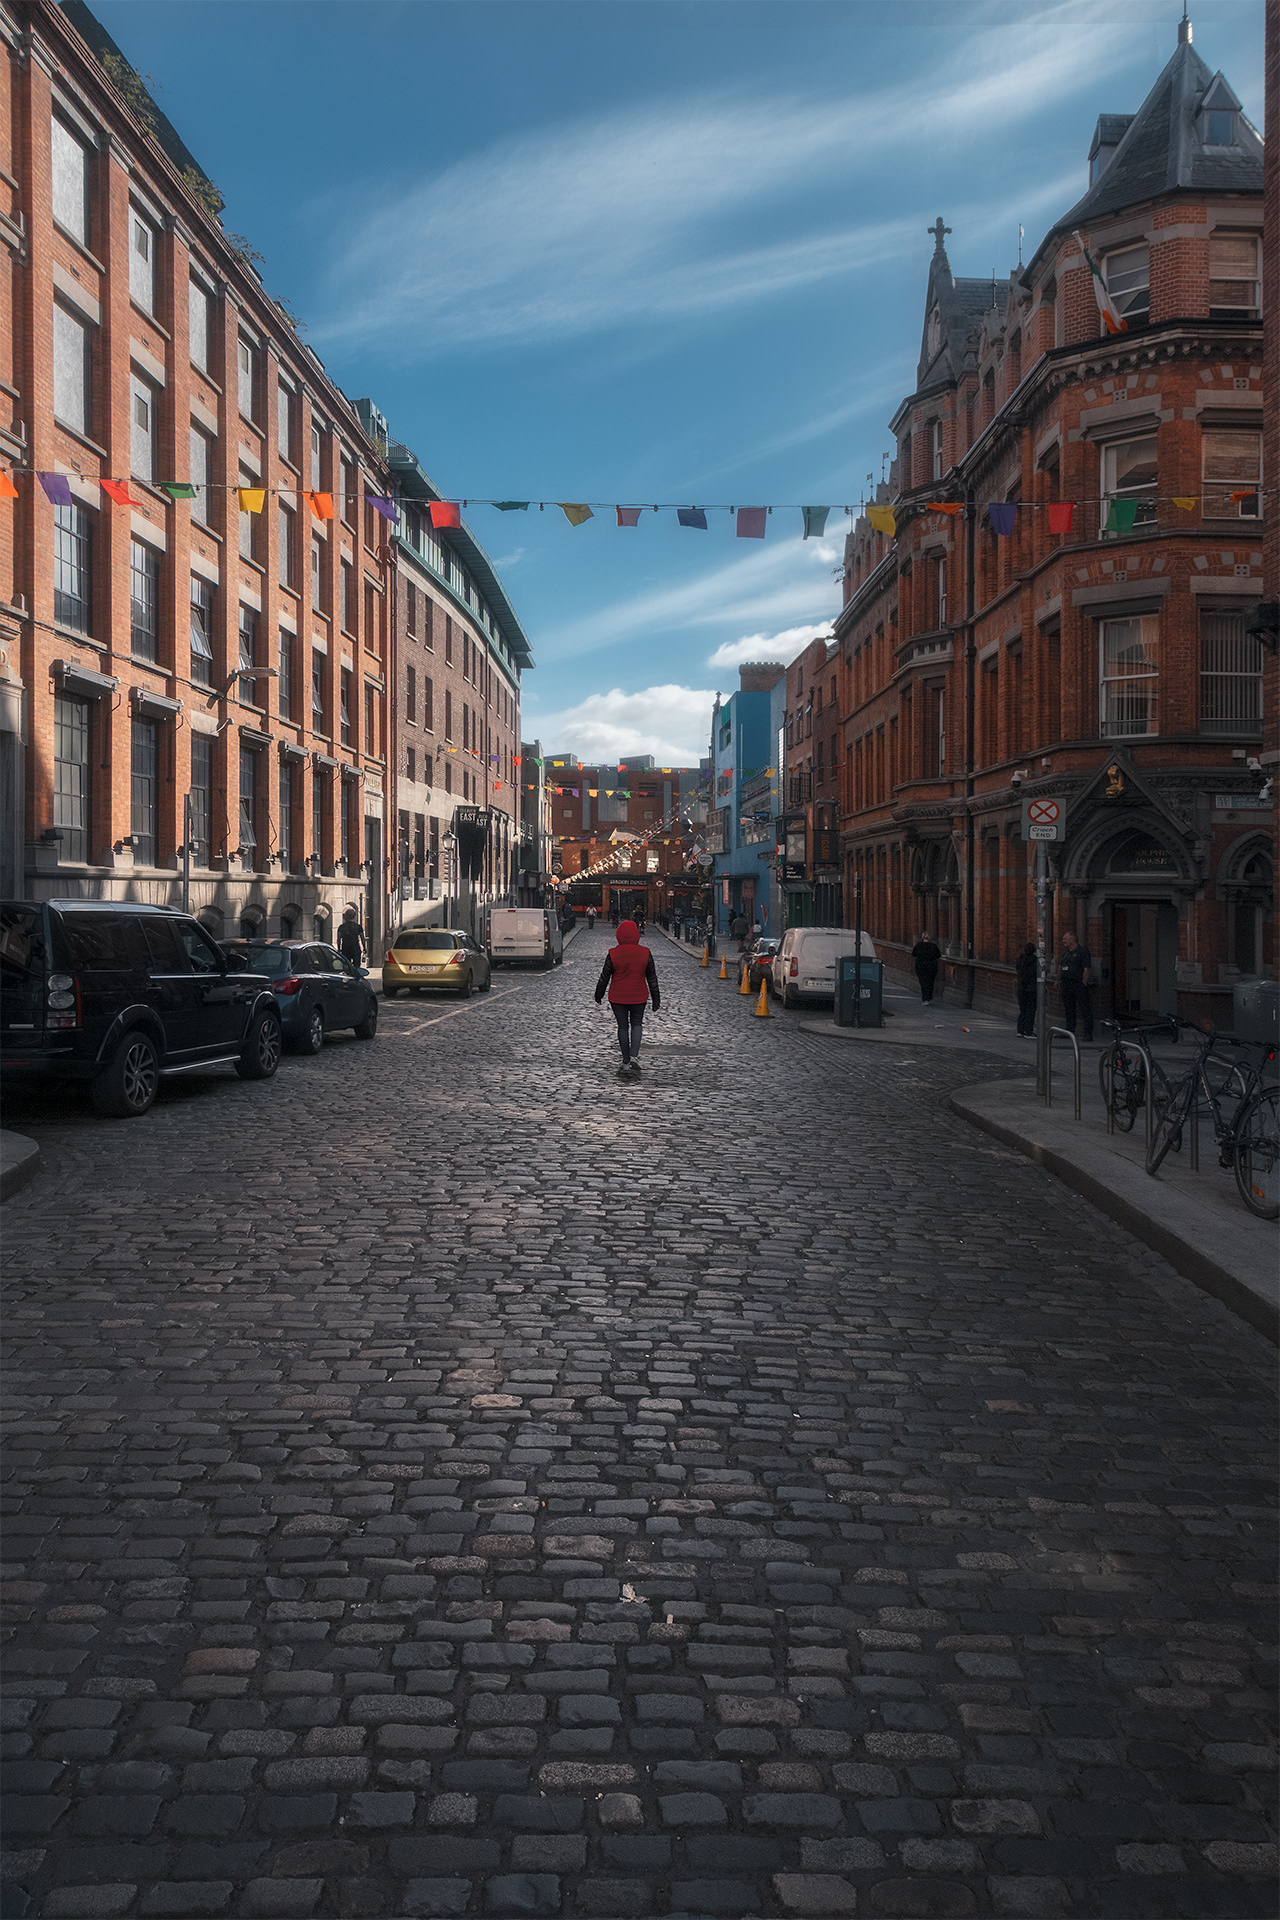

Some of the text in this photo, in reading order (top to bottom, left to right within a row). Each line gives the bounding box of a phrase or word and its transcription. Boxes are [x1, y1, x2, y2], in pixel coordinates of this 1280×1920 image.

[459, 812, 477, 822] EAST
[820, 833, 830, 860] JIGSAW
[1135, 857, 1168, 865] HOUSE
